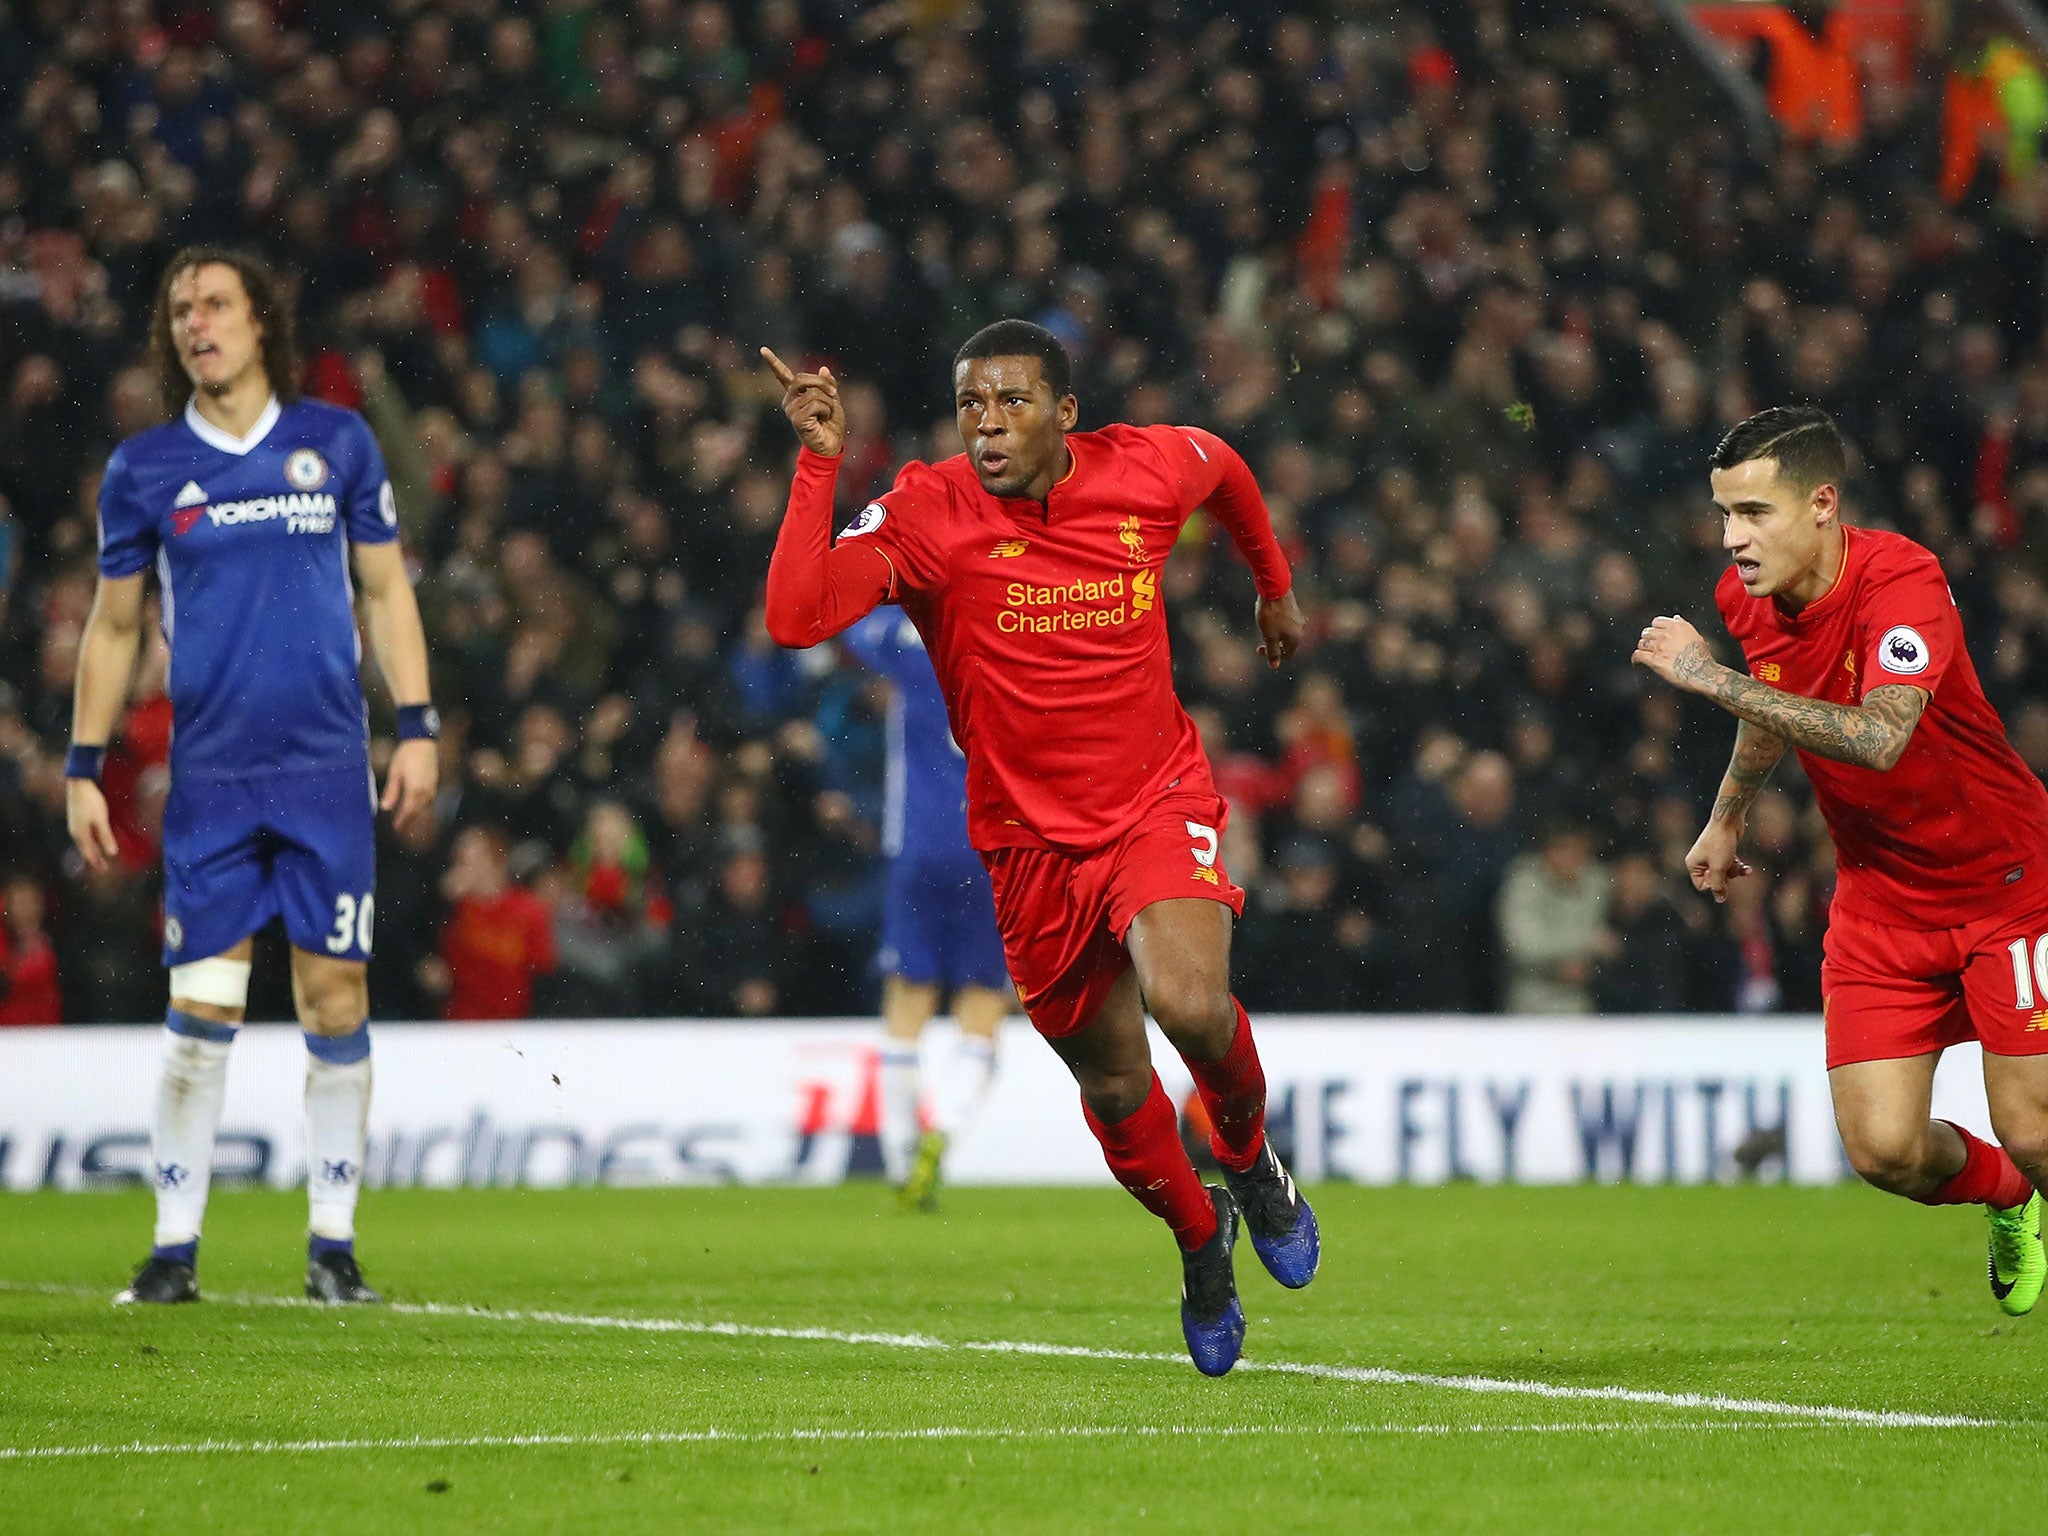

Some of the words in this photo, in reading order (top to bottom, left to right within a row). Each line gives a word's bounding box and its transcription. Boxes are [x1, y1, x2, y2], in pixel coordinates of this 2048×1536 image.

[207, 493, 337, 528] YOKOHAMA
[1006, 573, 1124, 606] Standard
[997, 602, 1125, 633] Chartered
[326, 892, 374, 955] 30
[1397, 1079, 1534, 1180] FLY
[1569, 1078, 1792, 1180] WITH
